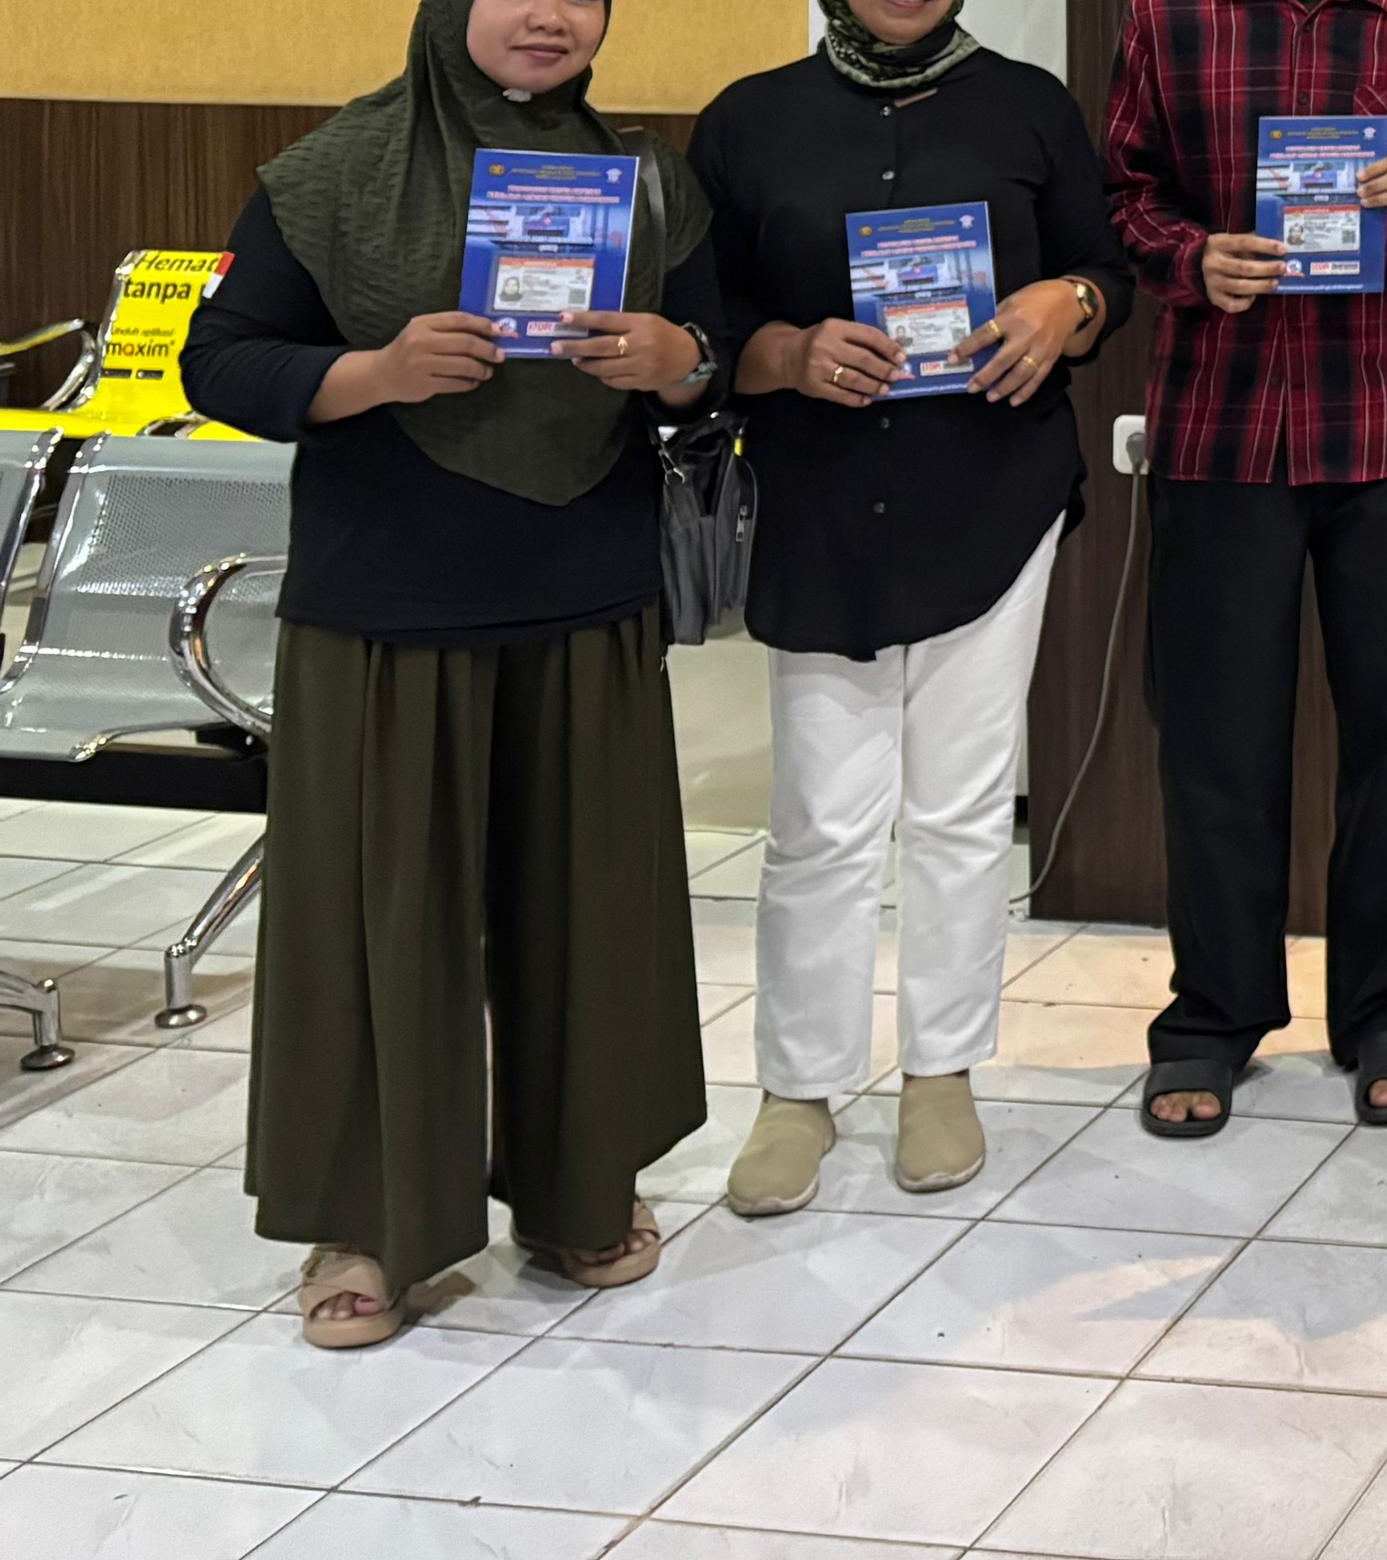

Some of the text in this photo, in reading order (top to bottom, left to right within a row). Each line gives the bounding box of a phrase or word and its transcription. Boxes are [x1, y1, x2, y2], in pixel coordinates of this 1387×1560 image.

[134, 253, 218, 272] Hemat
[123, 277, 191, 304] tanpa
[106, 339, 169, 357] maxim
